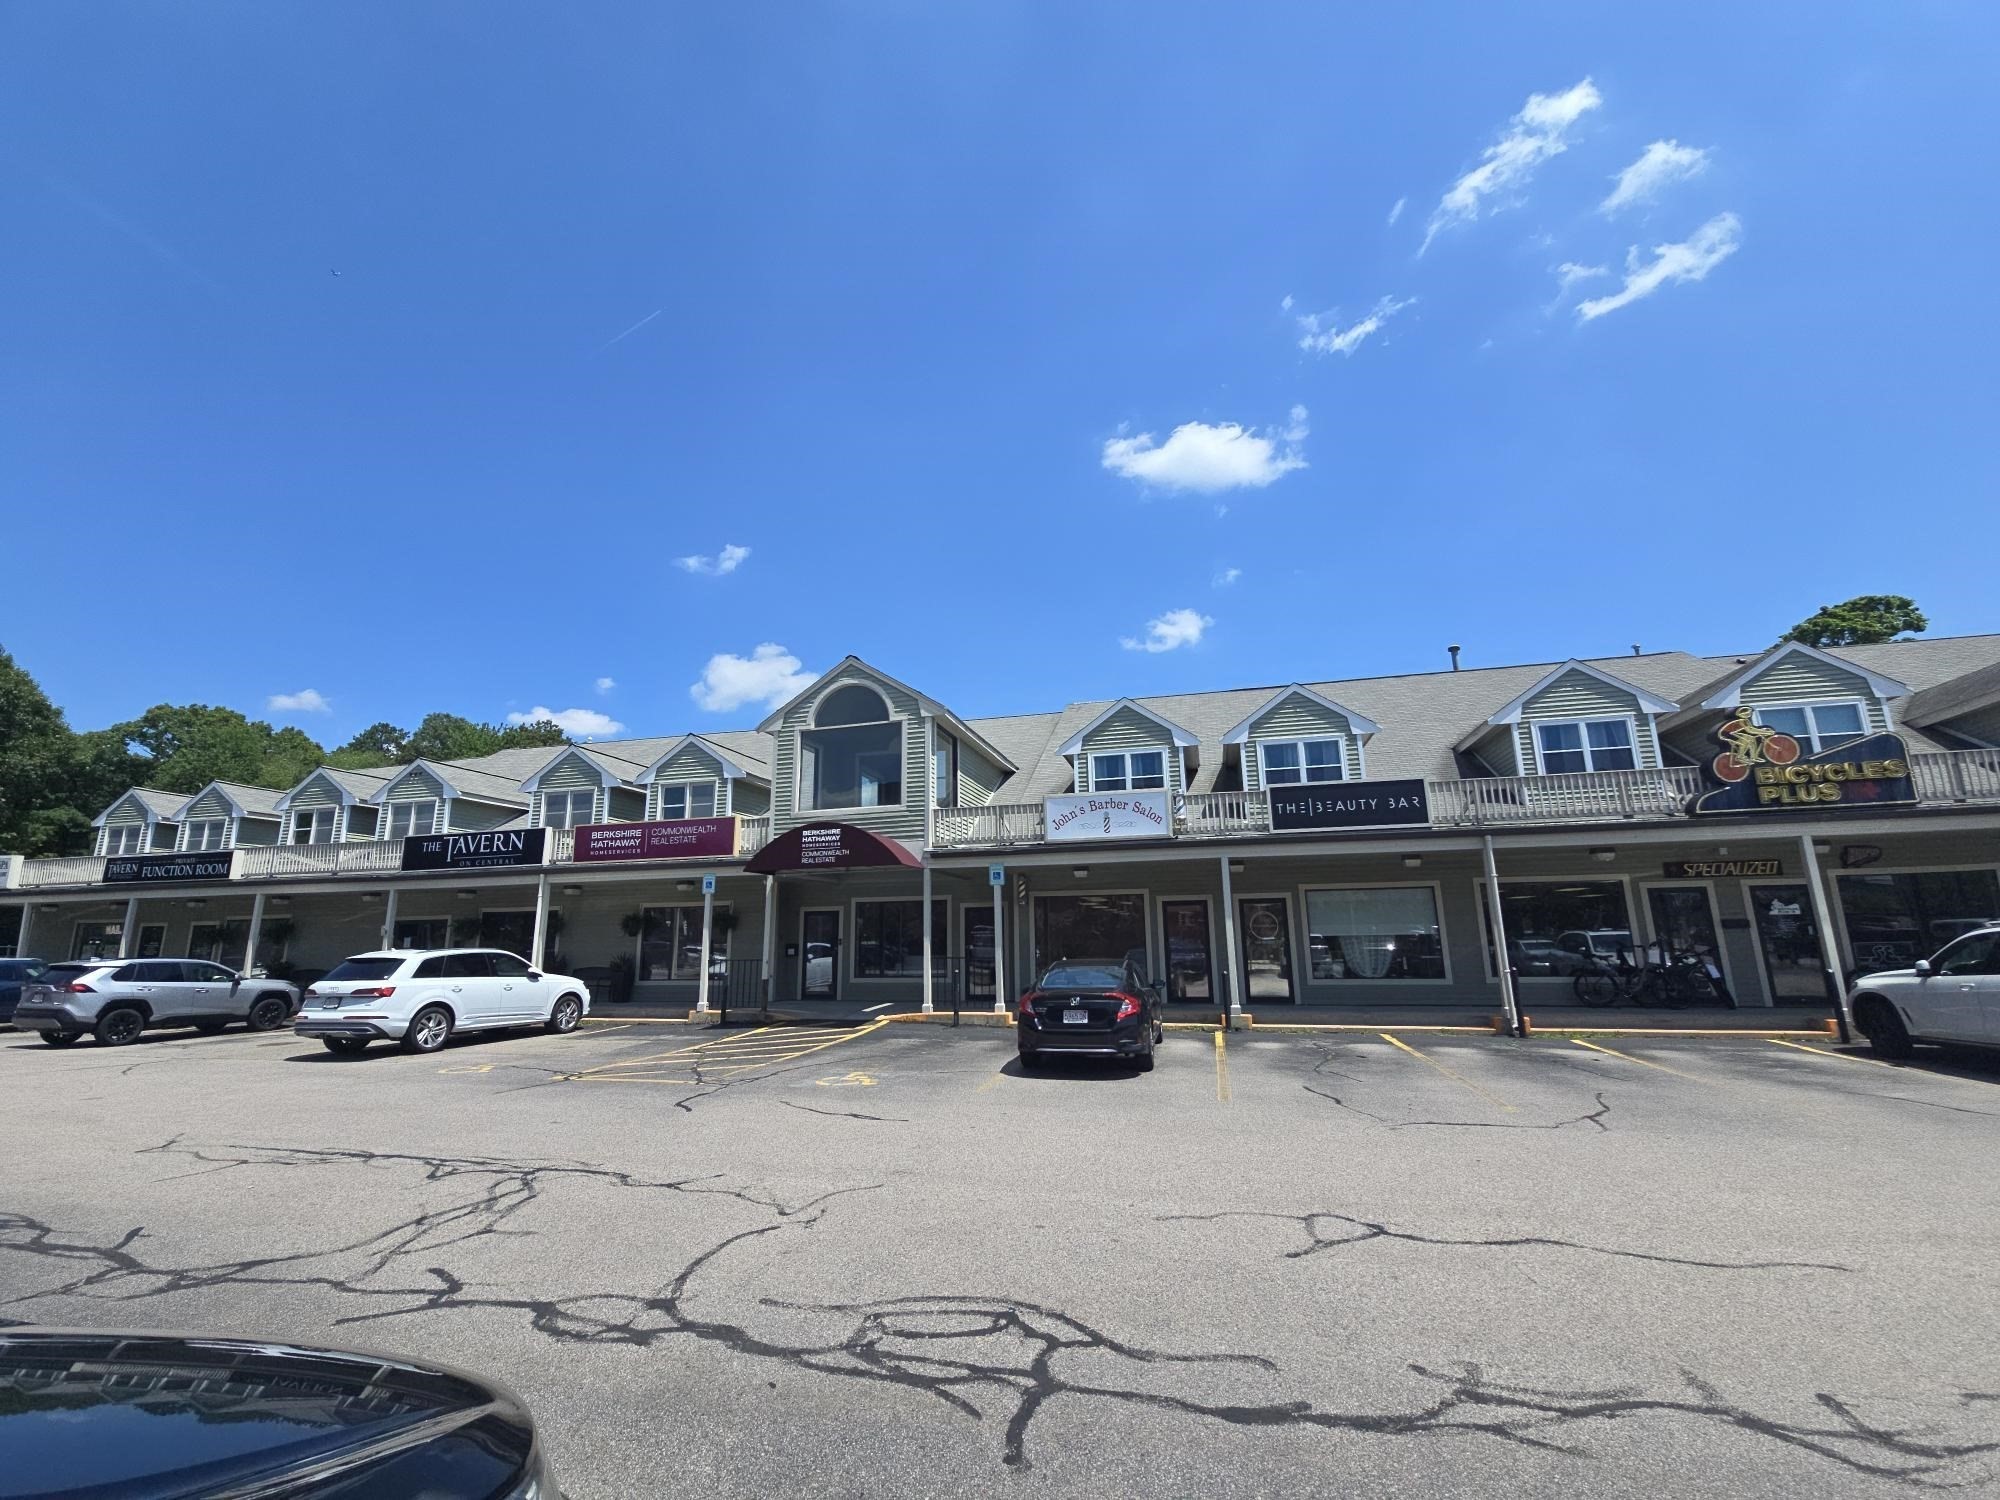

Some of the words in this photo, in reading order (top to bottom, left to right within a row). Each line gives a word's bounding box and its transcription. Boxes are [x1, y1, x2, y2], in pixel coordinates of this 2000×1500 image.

[1755, 759, 1909, 784] BICYCLES
[1757, 782, 1842, 804] PLUS
[1276, 802, 1306, 815] THE
[1315, 798, 1377, 813] BEAUTY
[1388, 796, 1421, 809] BAR
[1052, 805, 1086, 831] John's
[1088, 798, 1129, 812] Barber
[1131, 801, 1163, 825] Salon
[591, 829, 643, 839] BERKSHIRE
[651, 825, 717, 836] COMMONWEALTH
[802, 828, 841, 836] BERKSHIRE
[590, 839, 641, 849] HATHAWAY
[651, 836, 669, 845] REAL
[669, 835, 697, 845] ESTATE
[801, 835, 841, 843] HATHAWAY
[422, 841, 442, 853] THE
[443, 831, 526, 862] TAVERN
[589, 848, 641, 856] HOMESERVICES
[801, 849, 850, 857] COMMONWEALTH
[475, 858, 515, 866] CENTRAL
[815, 856, 836, 864] ESTATE
[107, 863, 139, 878] TAVERN
[141, 864, 194, 878] FUNCTION
[195, 862, 228, 875] ROOM
[1682, 860, 1779, 877] SPECIALIZED
